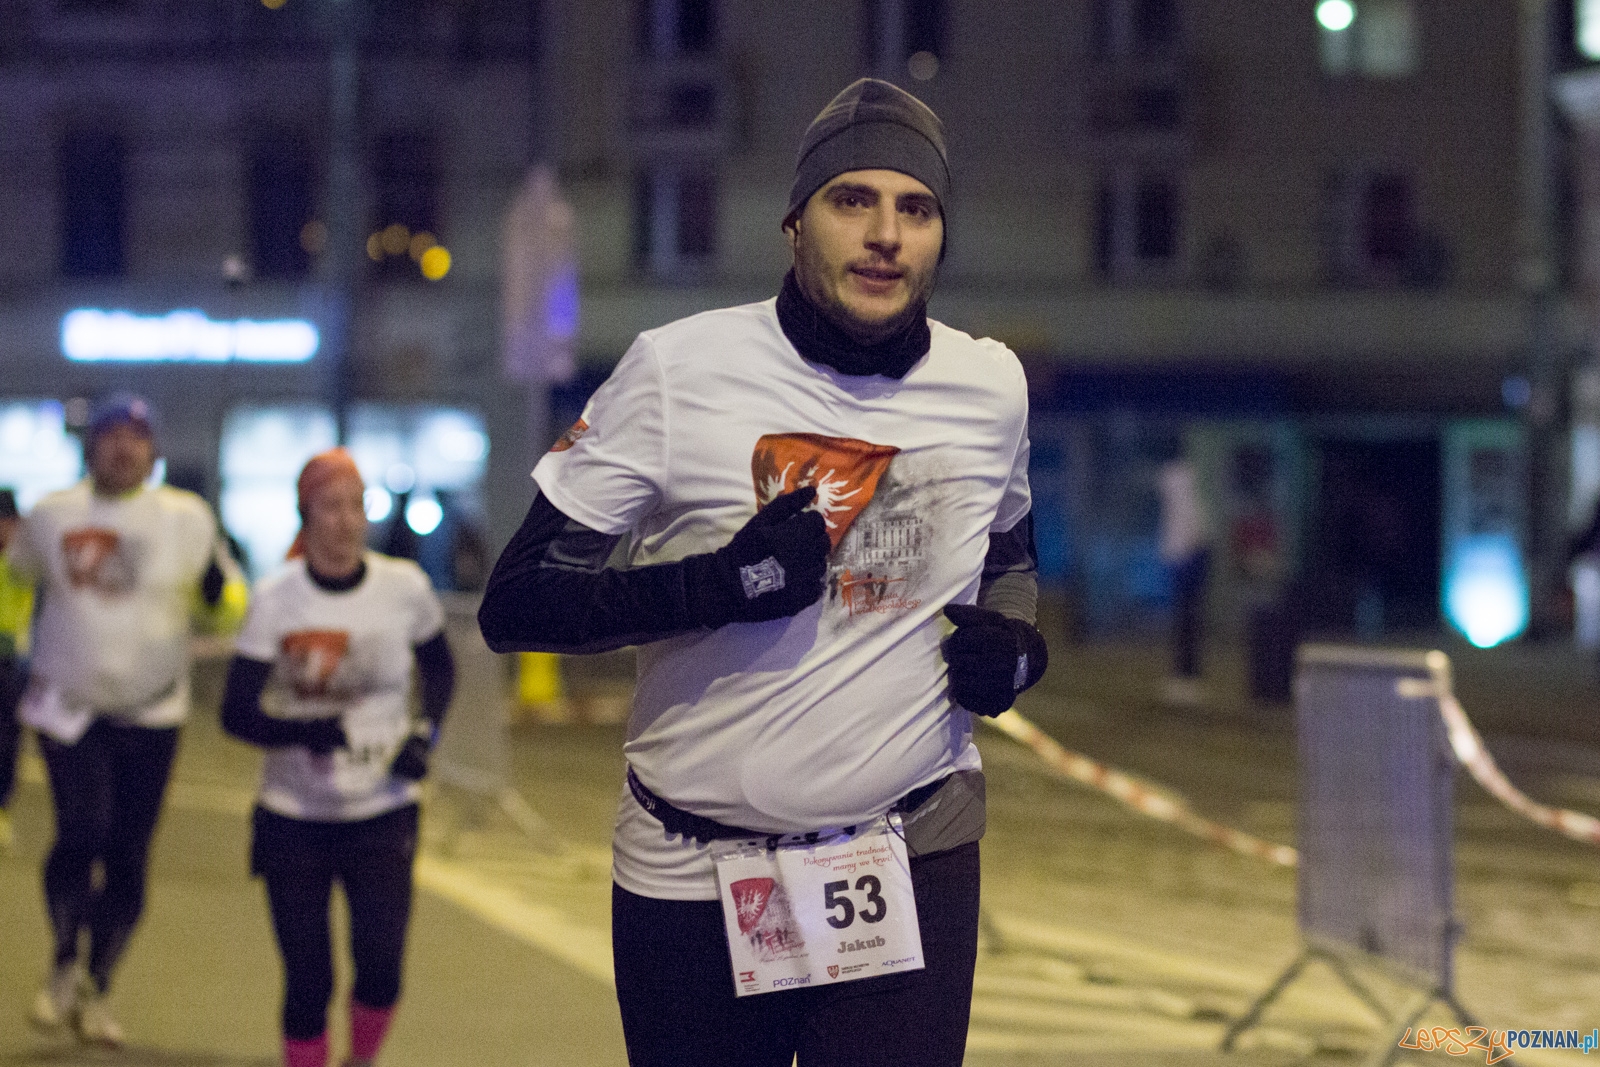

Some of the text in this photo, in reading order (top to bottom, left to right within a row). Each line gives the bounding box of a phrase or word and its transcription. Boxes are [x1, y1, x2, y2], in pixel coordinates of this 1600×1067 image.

[833, 862, 857, 874] mamy
[859, 859, 870, 867] we
[823, 873, 888, 930] 53
[837, 935, 886, 954] Jakub
